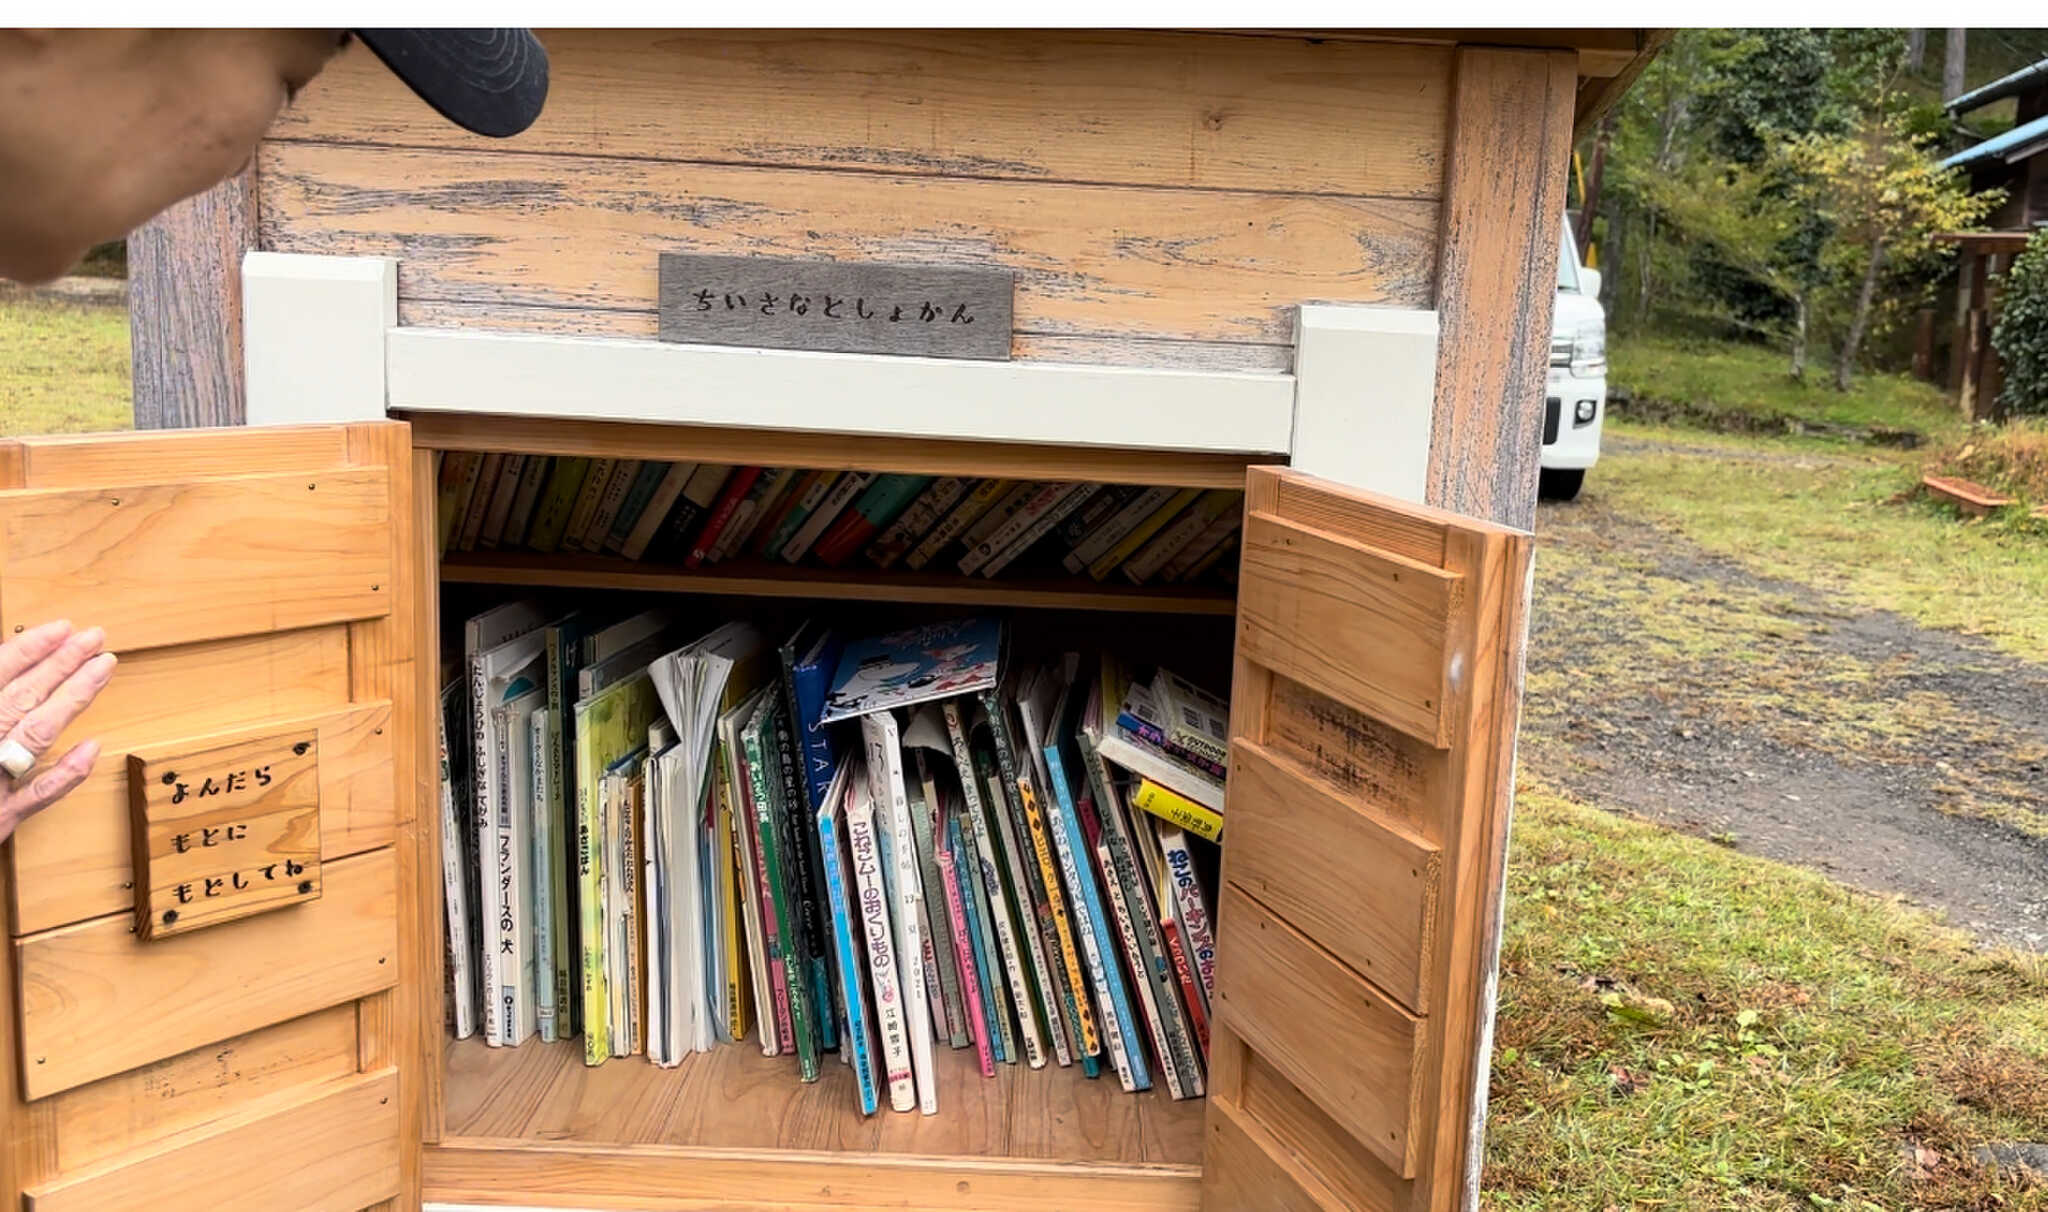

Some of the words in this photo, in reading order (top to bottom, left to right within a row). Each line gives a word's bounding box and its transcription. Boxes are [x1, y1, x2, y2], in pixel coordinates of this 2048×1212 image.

[693, 288, 974, 324] ちいさなとしょかん
[172, 766, 272, 804] よんだら
[171, 825, 247, 853] もとに
[173, 859, 303, 903] もどしてね
[500, 835, 514, 954] フランダースの犬
[853, 821, 890, 968] こねこムーのおくりもの
